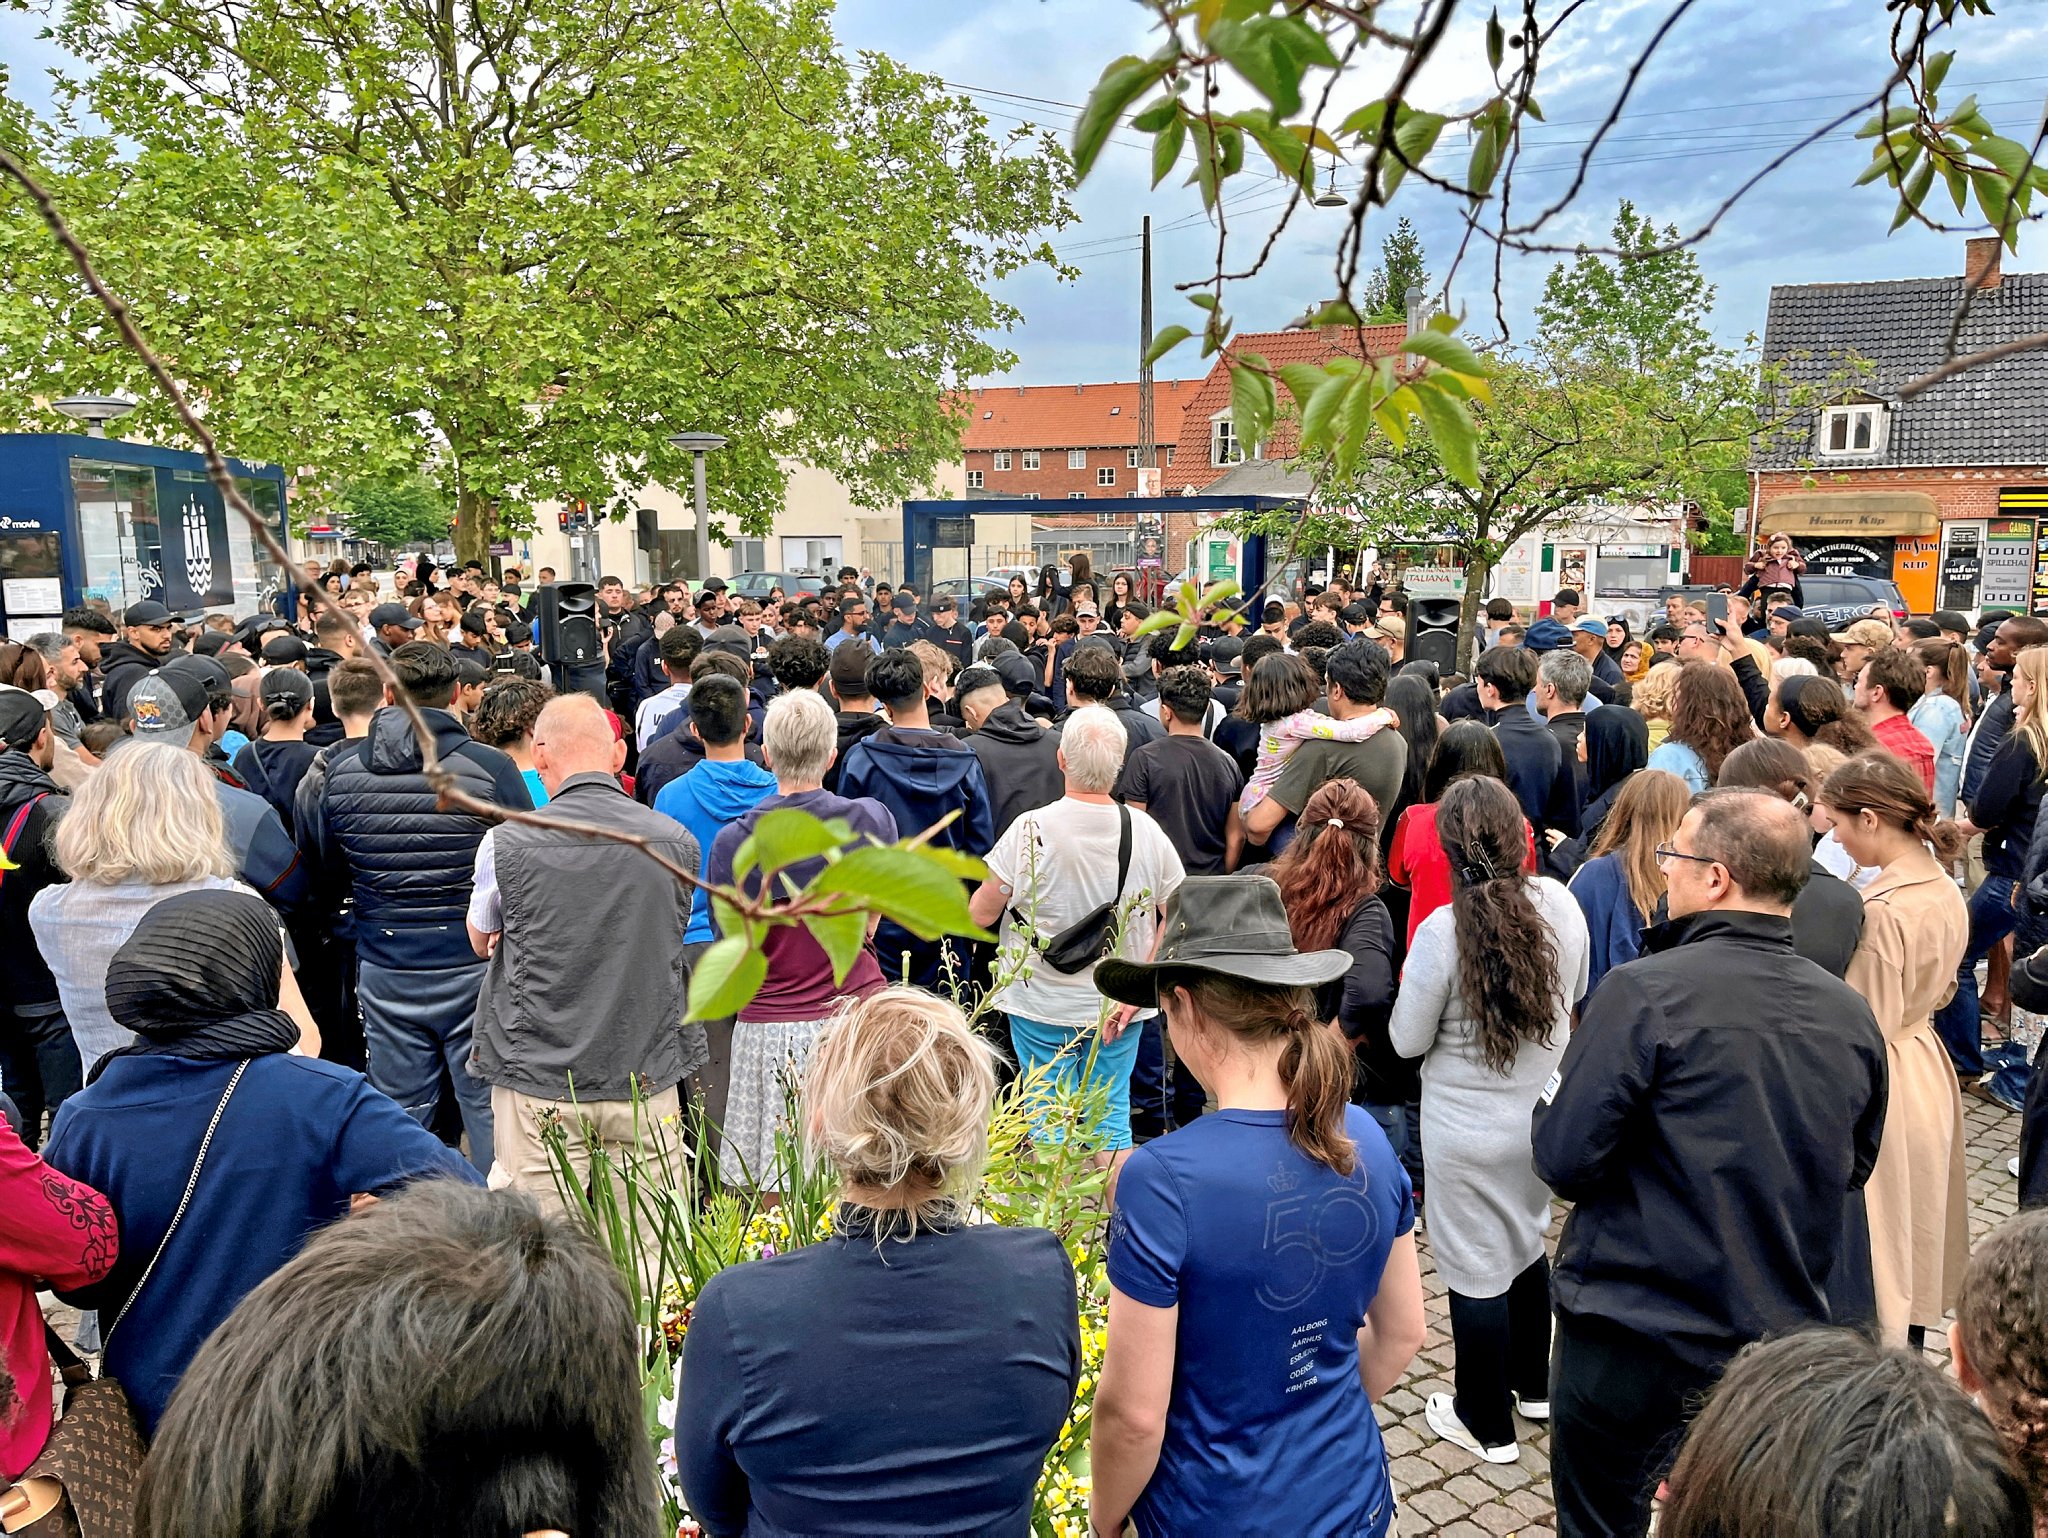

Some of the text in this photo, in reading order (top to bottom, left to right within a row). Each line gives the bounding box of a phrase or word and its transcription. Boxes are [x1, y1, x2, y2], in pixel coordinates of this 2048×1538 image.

[12, 518, 41, 529] movia
[1808, 514, 1886, 526] Husum Klip
[2008, 521, 2032, 534] GAMES
[1825, 565, 1855, 576] KLIP
[1902, 561, 1929, 569] KLIP
[1405, 574, 1450, 583] ITALIANA
[1254, 1186, 1380, 1312] 50
[1291, 1318, 1328, 1336] AALBORG
[1291, 1333, 1323, 1350] AARHUS
[1289, 1346, 1319, 1366] ESBJERG
[1289, 1359, 1315, 1380] ODENSE
